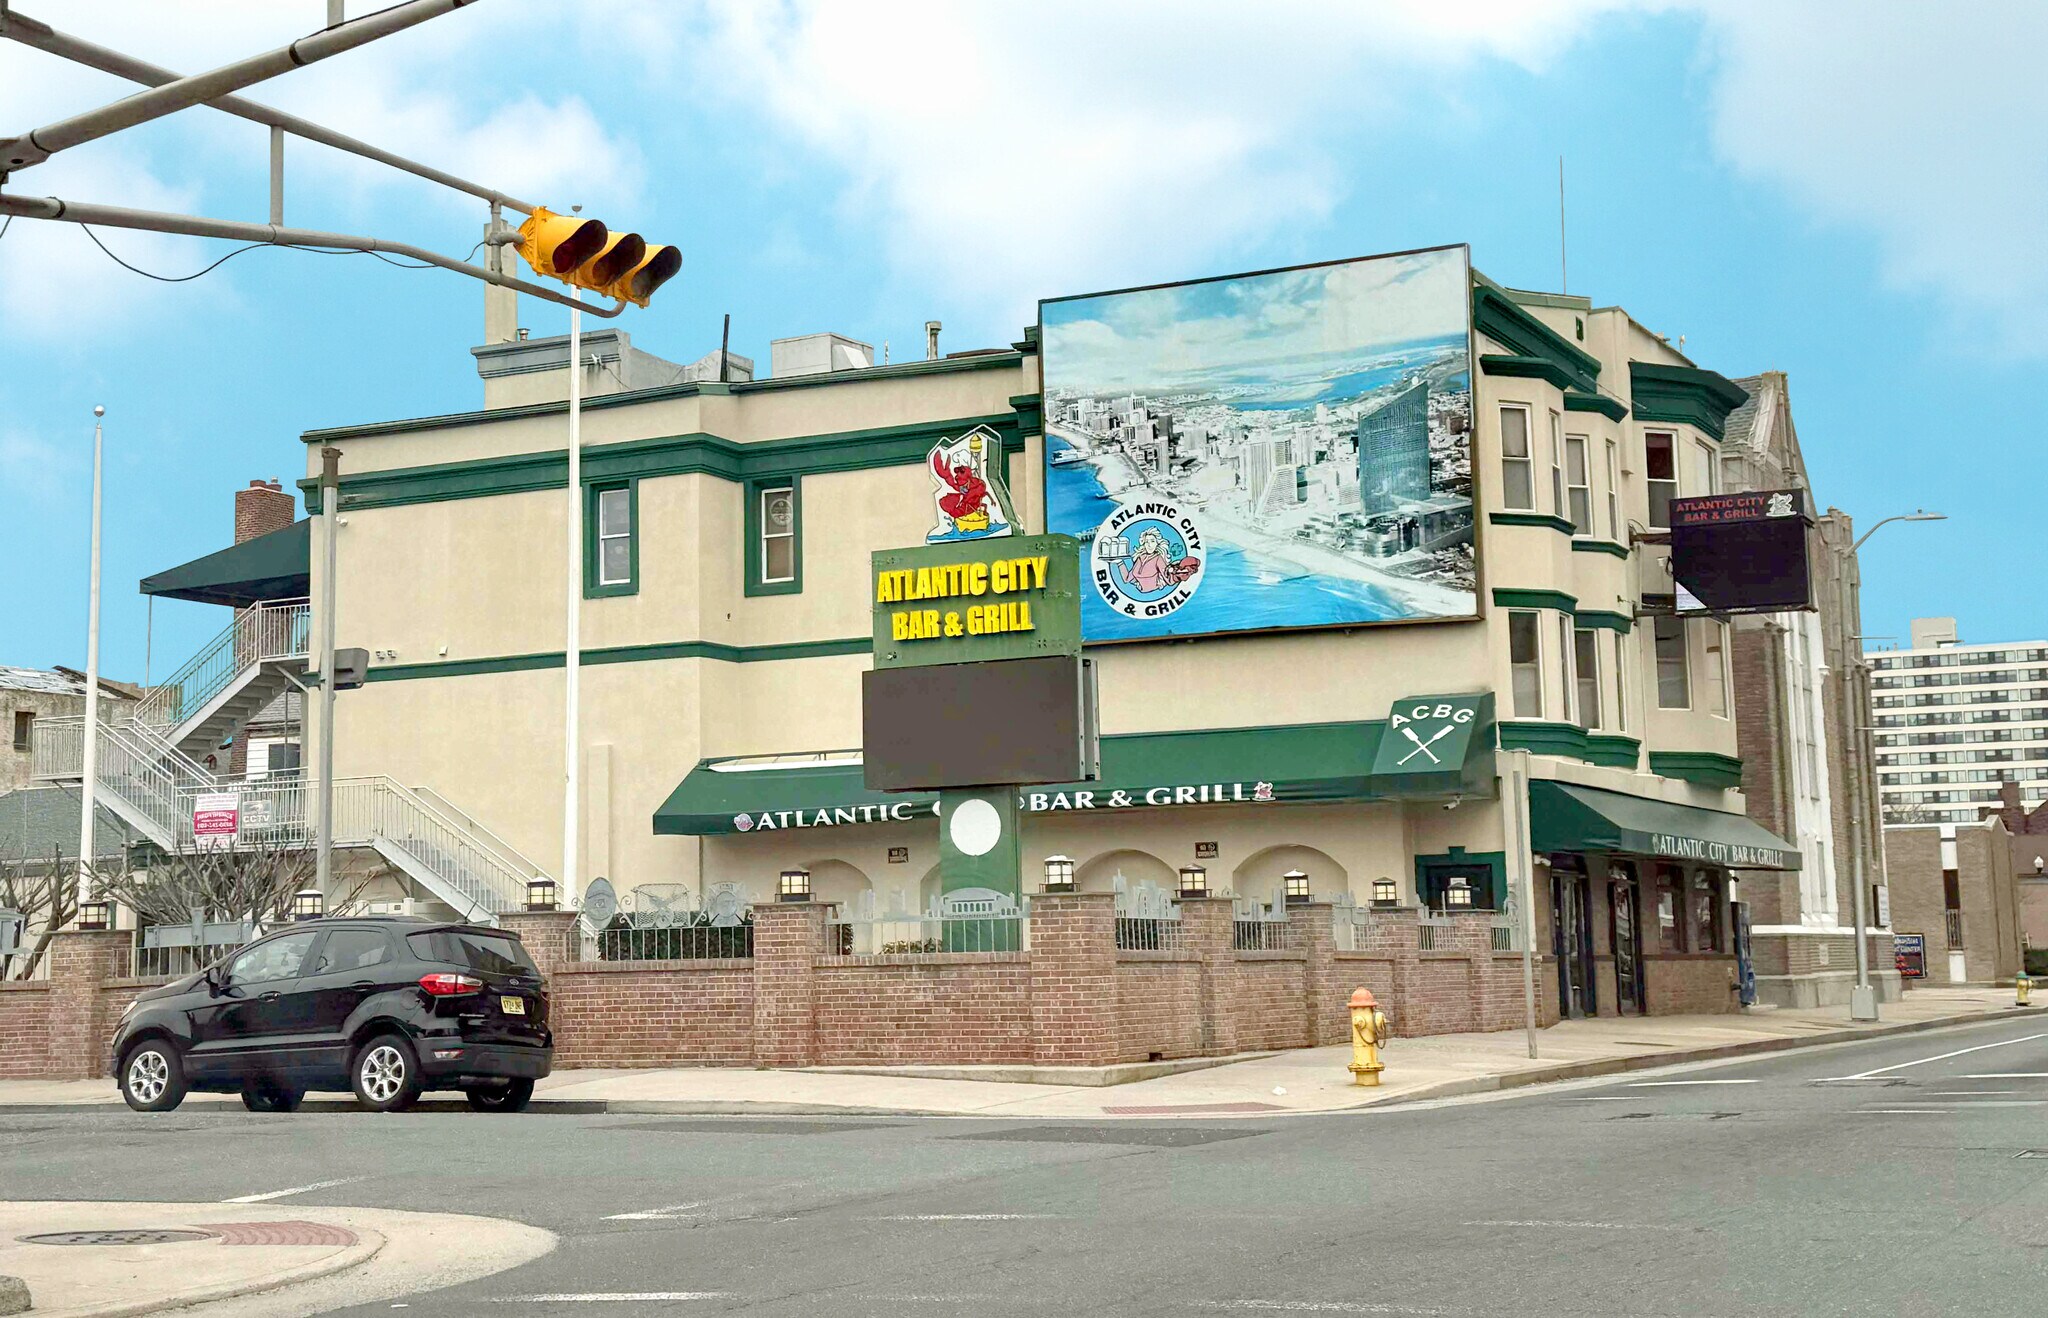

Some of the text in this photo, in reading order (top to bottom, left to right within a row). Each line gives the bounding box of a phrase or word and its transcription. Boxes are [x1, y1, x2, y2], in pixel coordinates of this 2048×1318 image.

[1677, 496, 1764, 512] ATLANTIC CITY
[1684, 508, 1758, 522] BAR & GRILL
[1111, 504, 1201, 550] ATLANTIC CITY
[877, 556, 1048, 603] ATLANTIC CITY
[1096, 569, 1192, 616] BAR & GRILL
[892, 601, 1036, 641] BAR & GRILL
[1392, 704, 1474, 729] ACBG
[243, 814, 270, 823] CCTV
[756, 802, 913, 830] ATLANTIC
[1030, 790, 1096, 812] BAR
[1108, 790, 1134, 808] &
[1145, 783, 1251, 806] GRILL
[1660, 836, 1779, 866] ATLANTIC CITY BAR & GRILL
